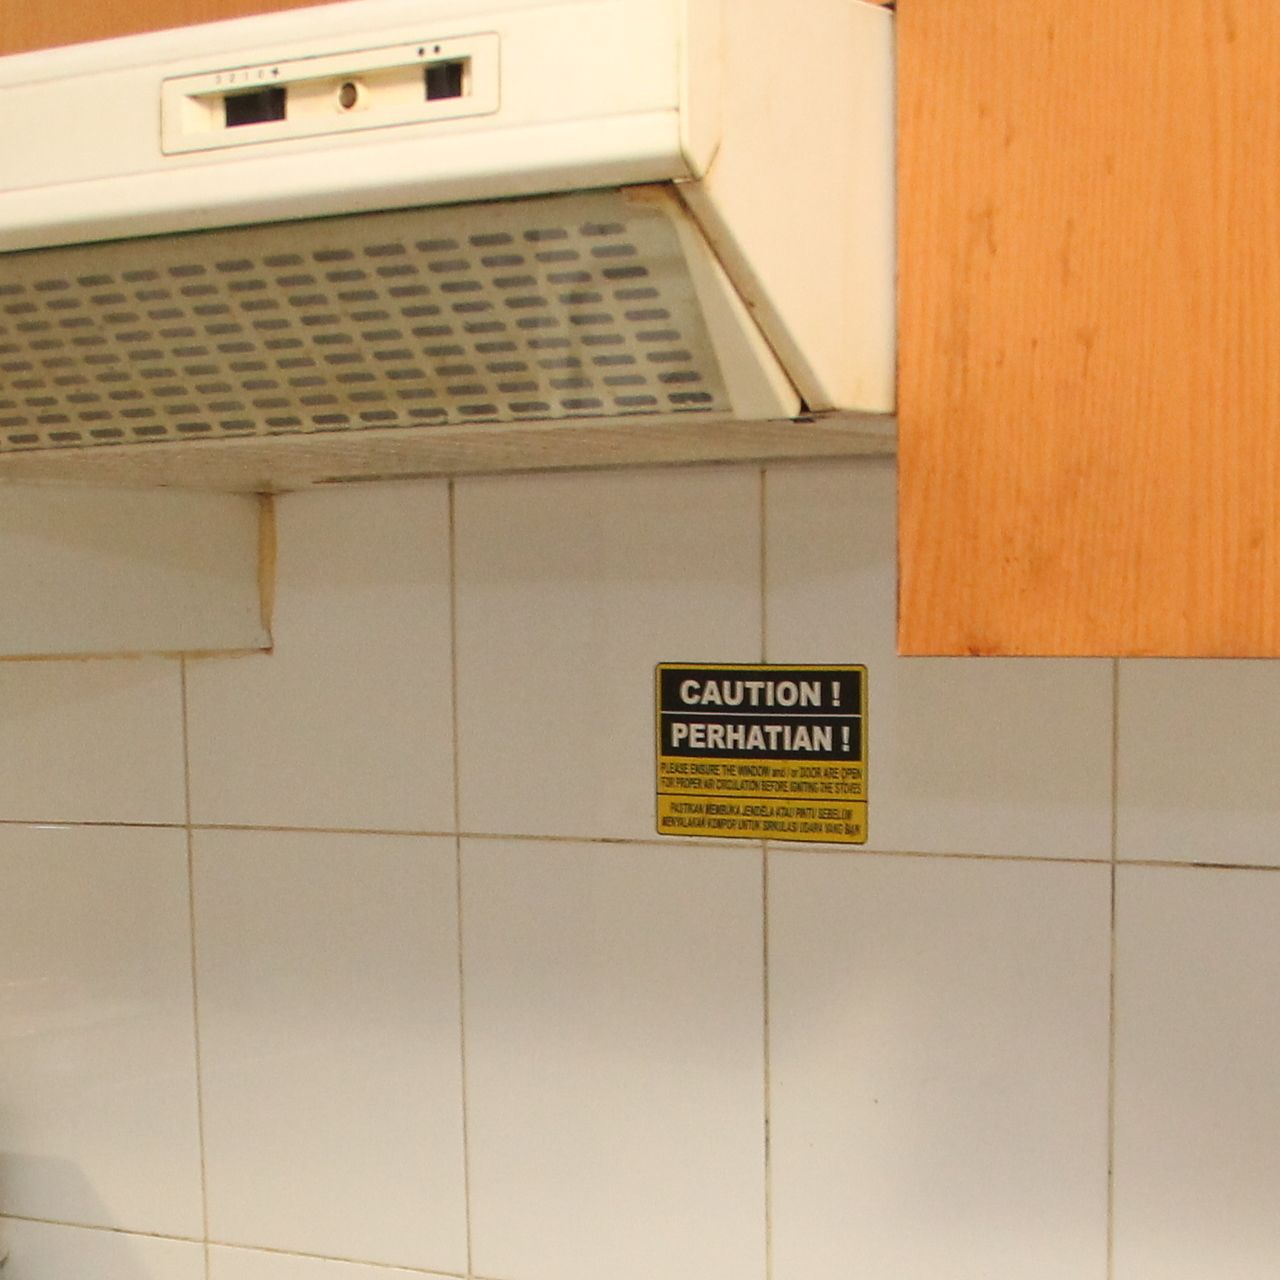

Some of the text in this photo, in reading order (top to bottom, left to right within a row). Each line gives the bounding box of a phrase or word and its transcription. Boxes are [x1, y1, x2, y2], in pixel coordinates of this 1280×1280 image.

[679, 679, 841, 707] CAUTION !
[671, 722, 850, 752] PERHATIAN !
[691, 763, 720, 775] ENSURE
[722, 765, 737, 776] THE
[738, 765, 769, 777] WINDOW
[800, 767, 821, 779] DOOR
[824, 768, 839, 780] ARE
[841, 768, 862, 780] OPEN
[676, 777, 702, 789] PROPER
[715, 779, 760, 791] CIRCULATION
[761, 780, 789, 792] BEFORE
[820, 782, 835, 794] THE
[705, 803, 740, 816] MEMBUKA
[741, 805, 774, 817] JENDELA
